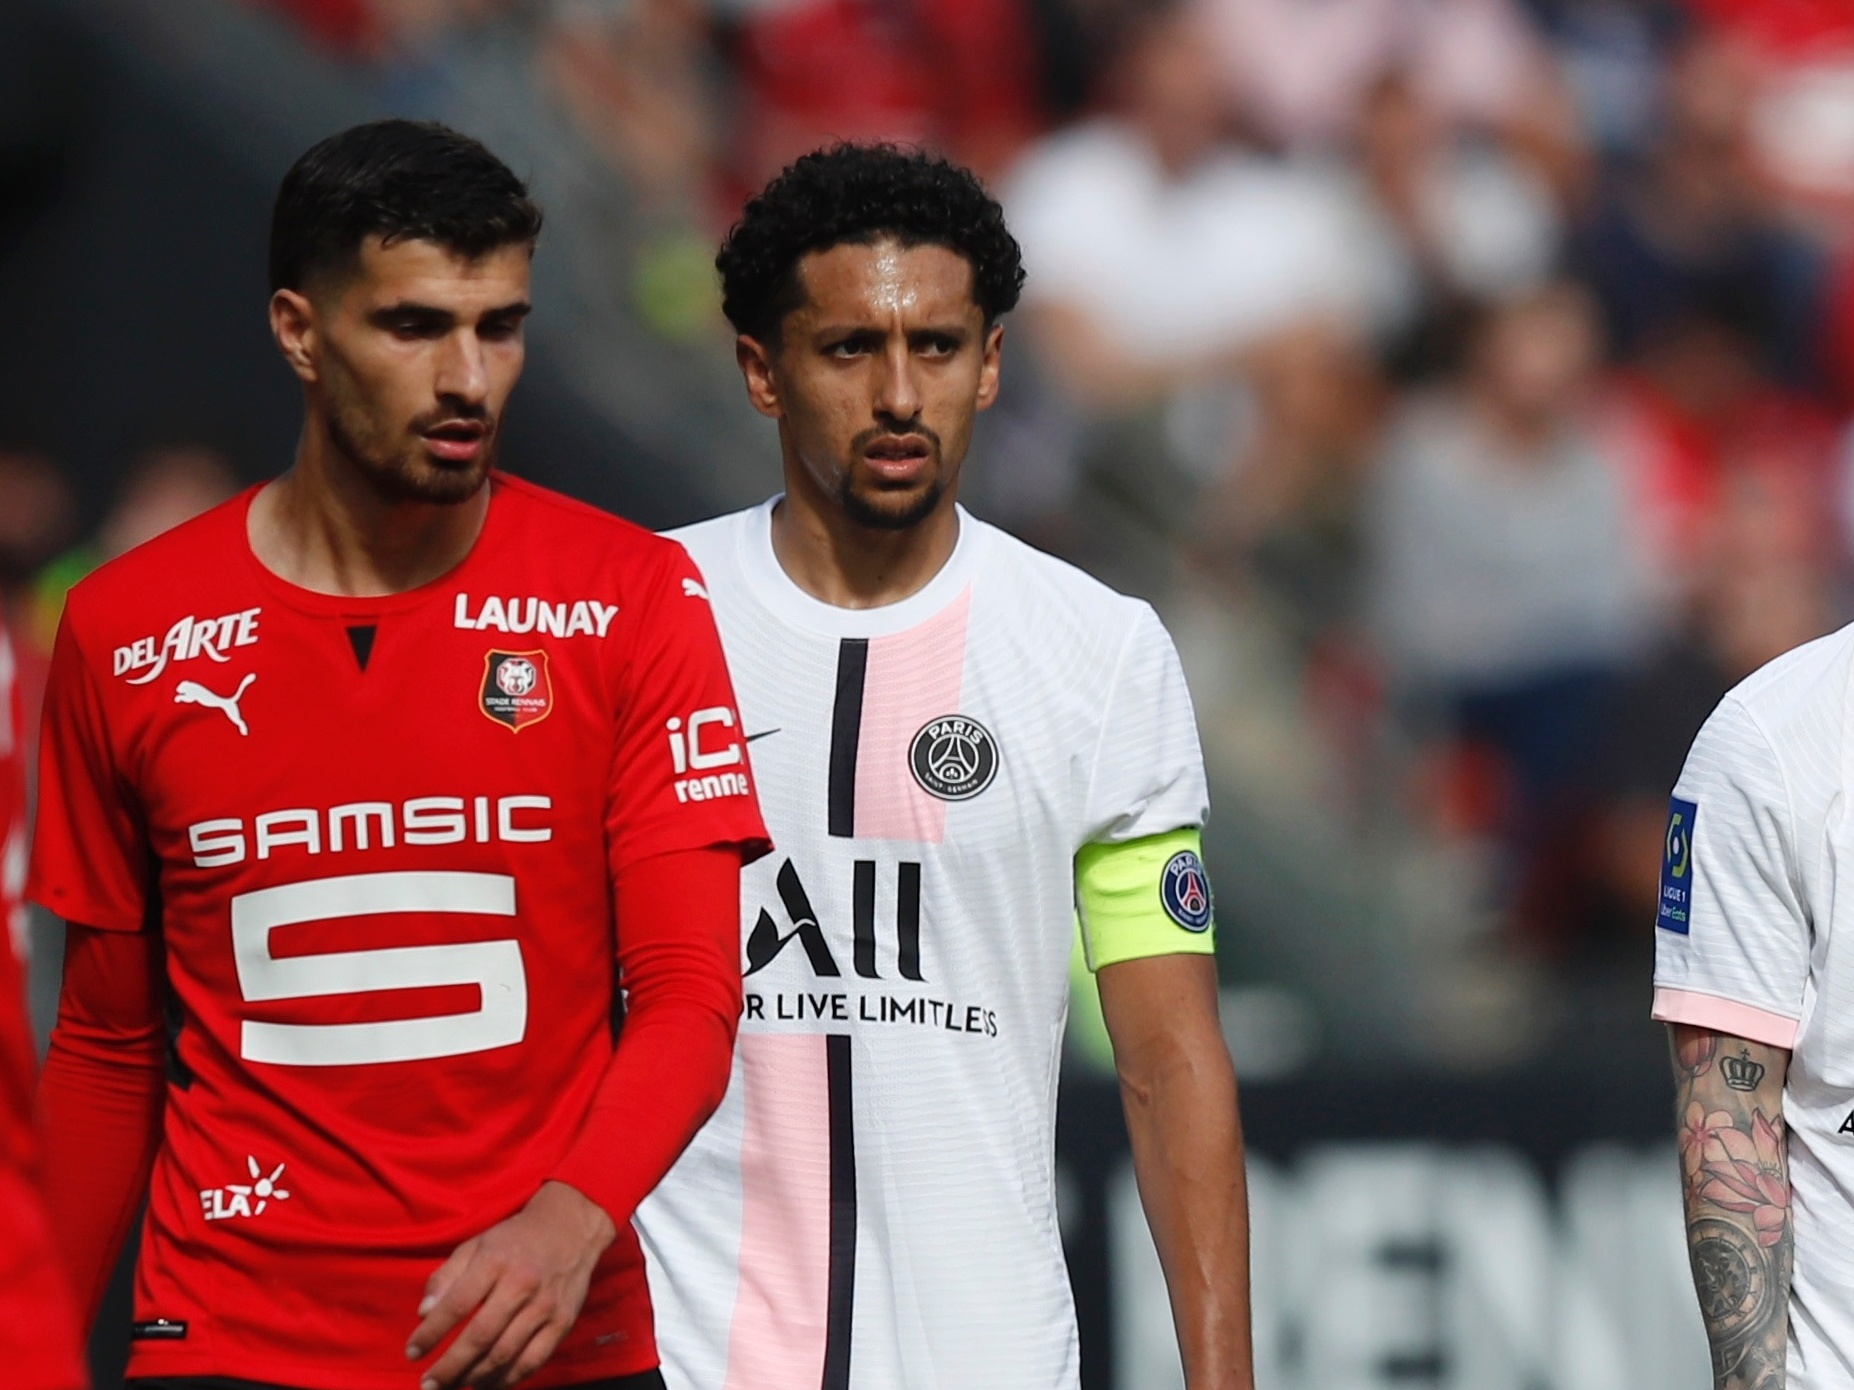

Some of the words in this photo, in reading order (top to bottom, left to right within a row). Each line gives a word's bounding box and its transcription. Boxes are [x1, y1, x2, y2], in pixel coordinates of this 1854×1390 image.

[454, 592, 619, 638] LAUNAY
[928, 721, 983, 744] PARIS
[189, 795, 552, 867] SAMSIC
[777, 994, 849, 1020] LIVE
[859, 996, 998, 1037] LIMITLESS
